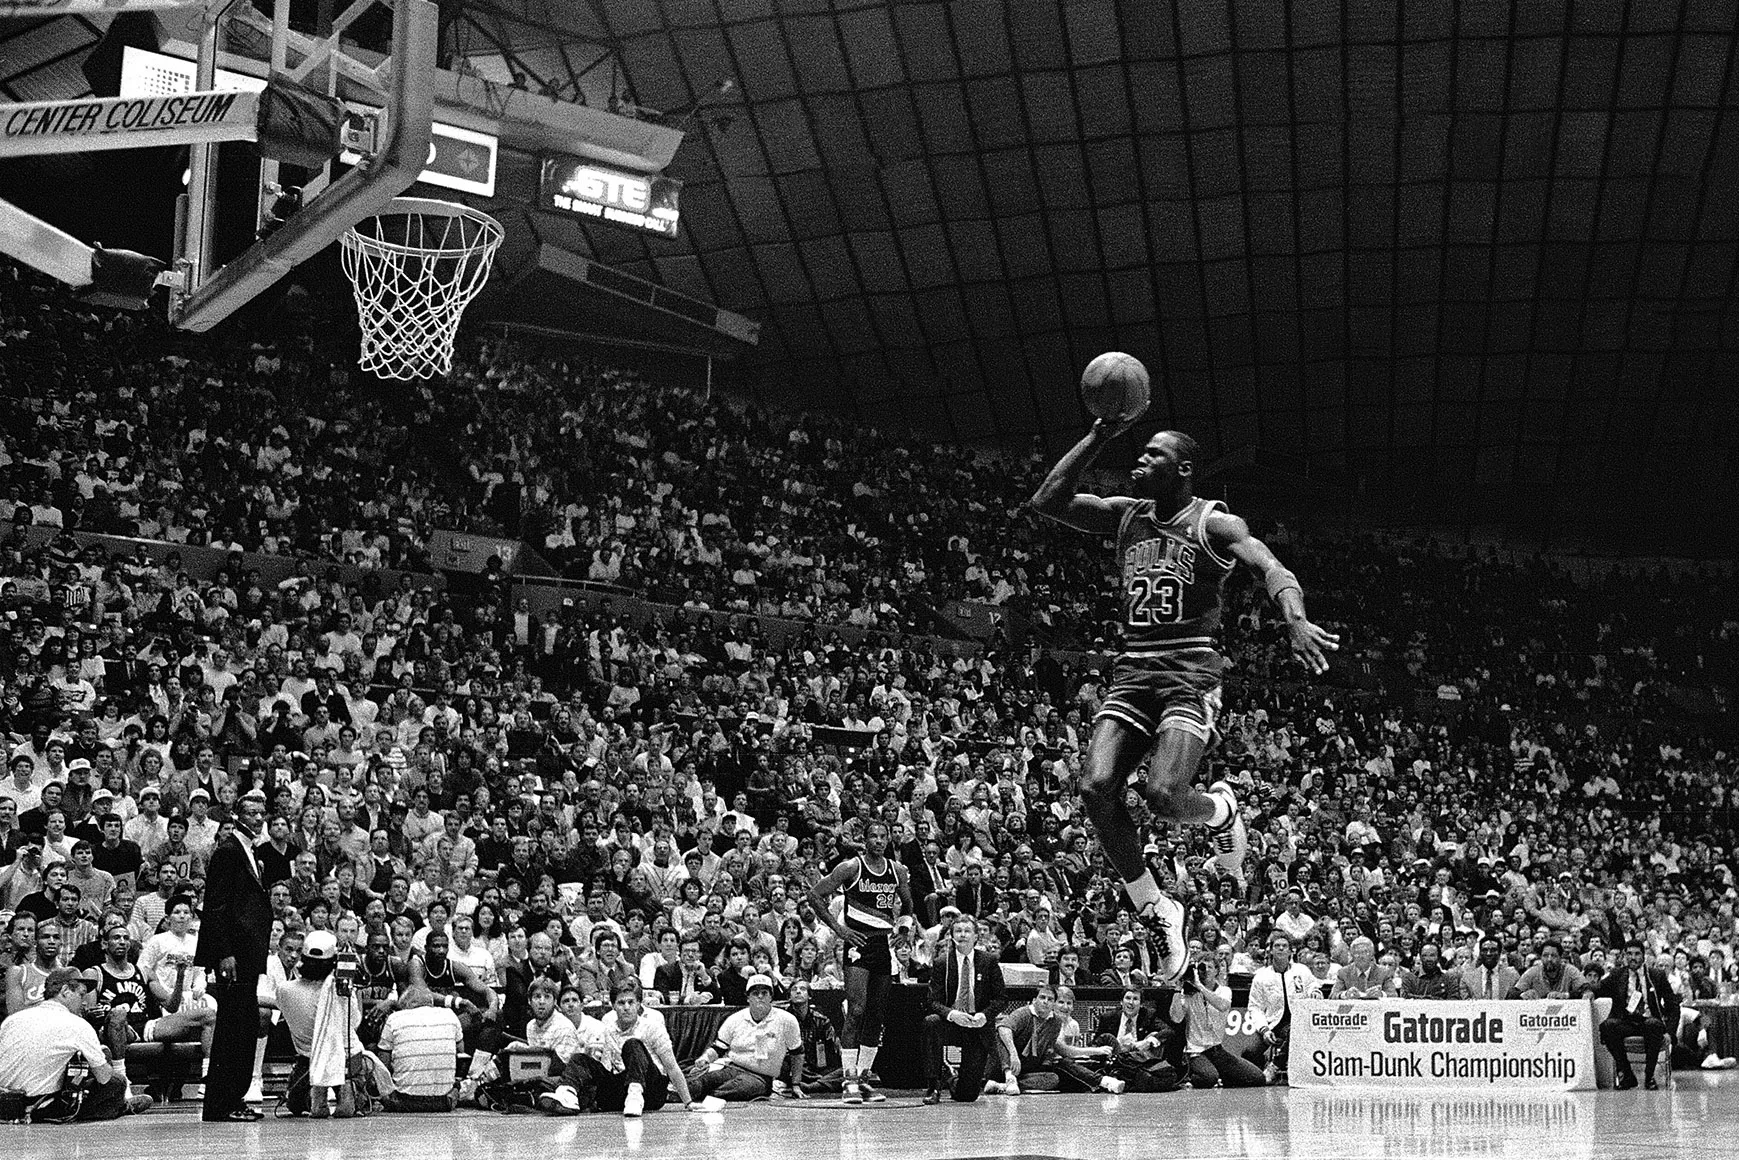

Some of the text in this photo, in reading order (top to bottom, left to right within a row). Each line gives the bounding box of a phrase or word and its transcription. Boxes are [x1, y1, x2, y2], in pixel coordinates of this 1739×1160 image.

[5, 93, 238, 137] CENTER COLISEUM
[575, 166, 649, 210] GTE
[1123, 538, 1196, 587] BULLS
[1128, 576, 1184, 625] 23
[1312, 1013, 1368, 1026] Gatorade
[1384, 1011, 1503, 1043] Gatorade
[1519, 1014, 1577, 1028] Gatorade
[1312, 1050, 1576, 1083] Slam-Dunk Championship
